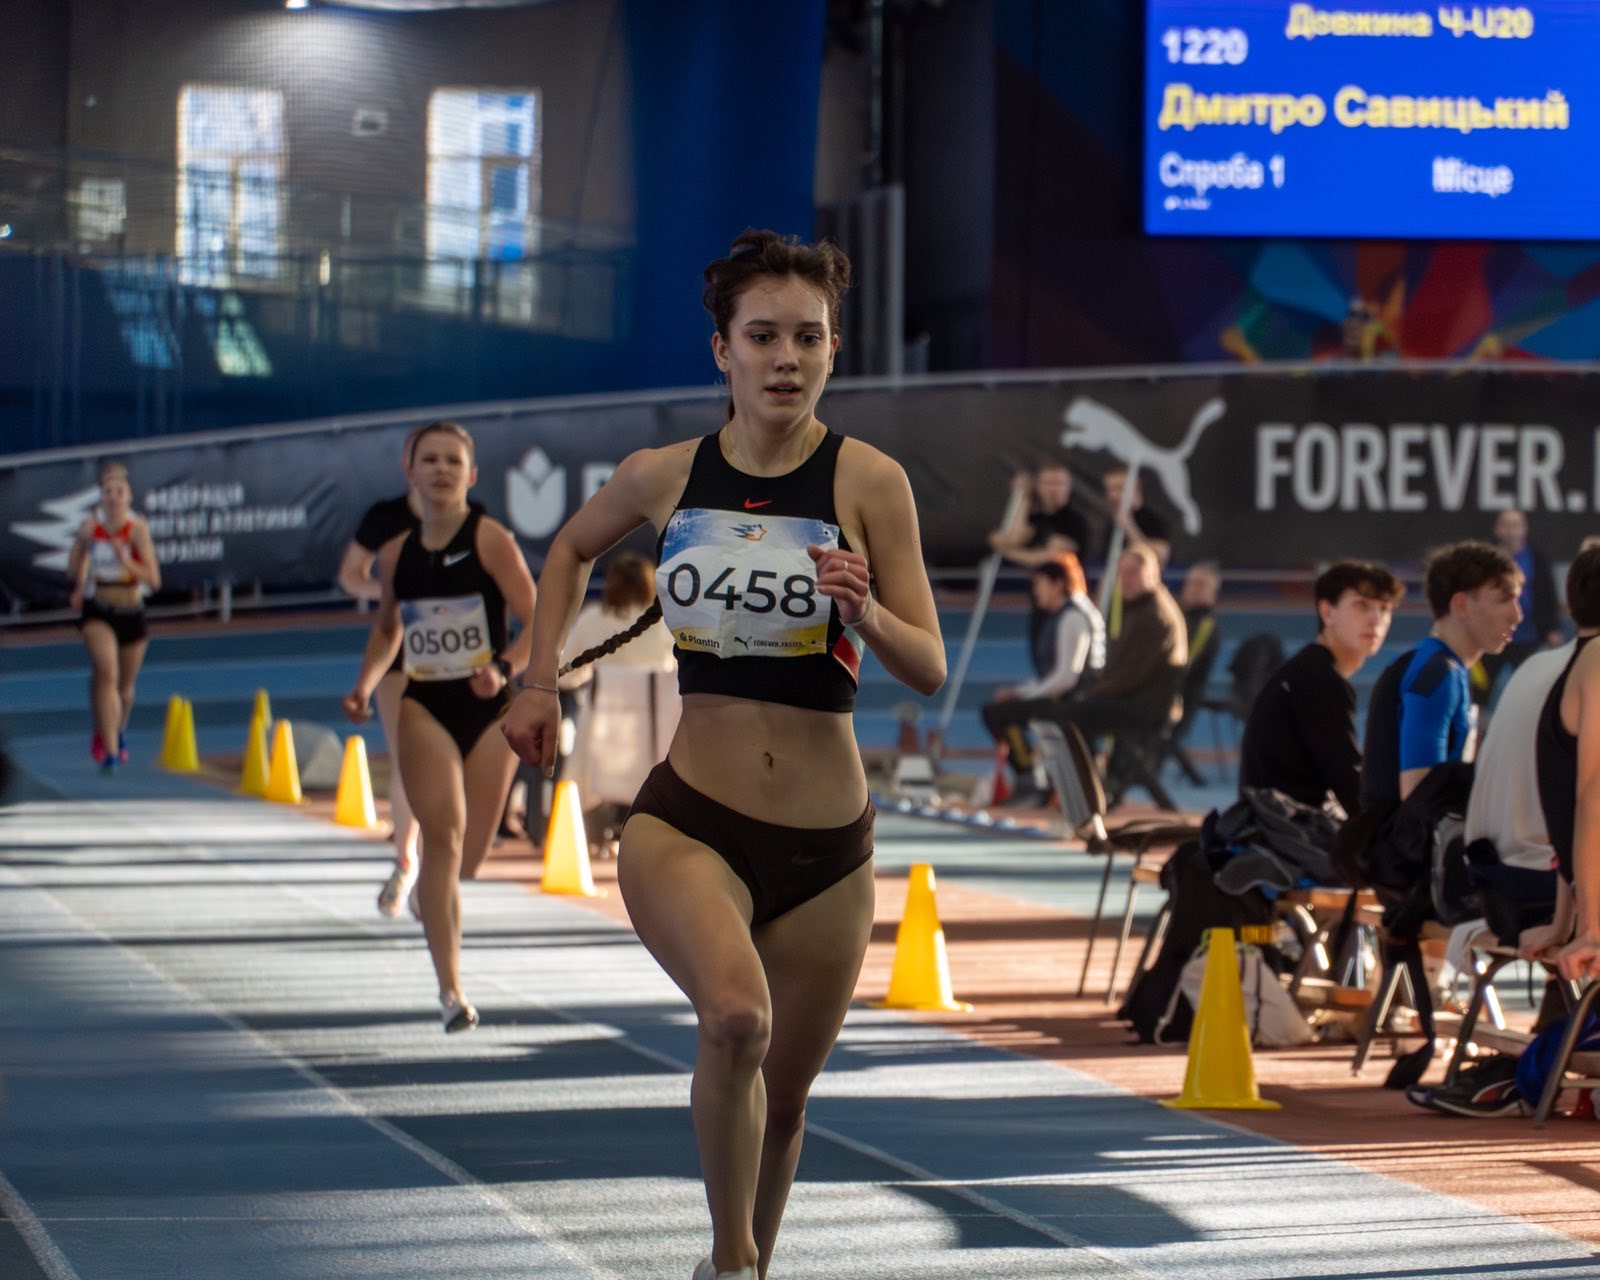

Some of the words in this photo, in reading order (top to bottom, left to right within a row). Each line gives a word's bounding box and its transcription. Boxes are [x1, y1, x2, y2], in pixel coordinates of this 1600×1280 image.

[1286, 3, 1433, 40] Довжина
[1162, 28, 1249, 65] 1220
[1158, 83, 1327, 134] Дмитро
[1334, 85, 1569, 134] Савицький
[1159, 151, 1263, 197] Спроба
[1269, 155, 1285, 188] 1
[1432, 157, 1514, 198] Місце
[1255, 424, 1600, 511] FOREVER.
[667, 563, 817, 618] 0458
[409, 625, 482, 655] 0508
[688, 635, 720, 648] Plantin
